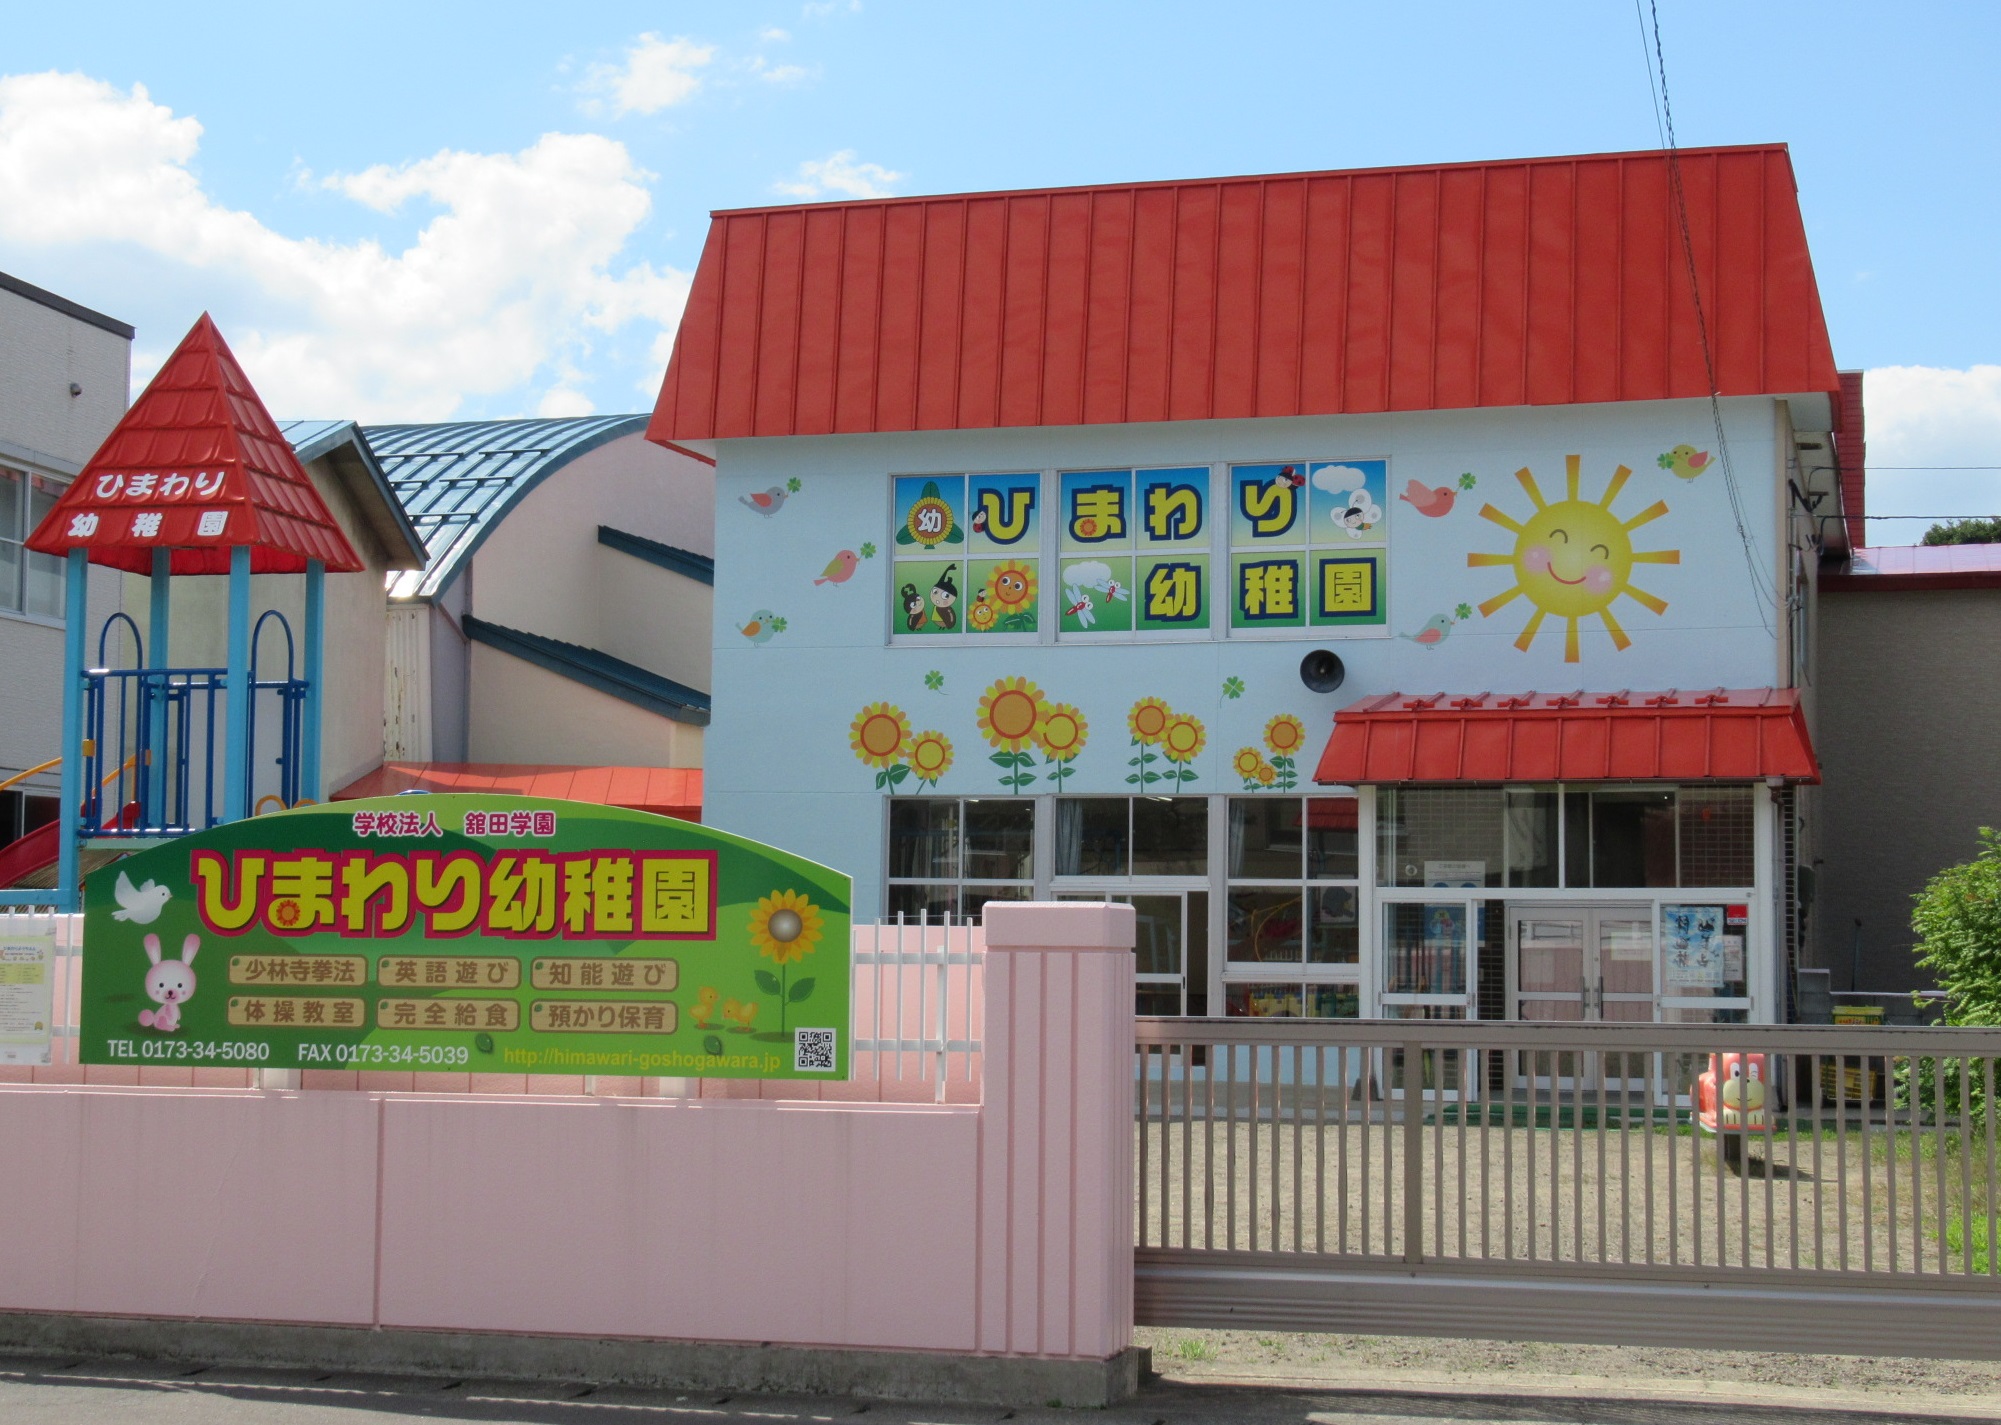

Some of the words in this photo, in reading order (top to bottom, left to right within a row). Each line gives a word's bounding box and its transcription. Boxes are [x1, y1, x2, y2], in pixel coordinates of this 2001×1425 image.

[96, 471, 225, 498] ひまわり
[68, 511, 229, 537] 幼稚園
[917, 507, 943, 534] 幼
[978, 480, 1298, 544] ひまわり
[1145, 556, 1377, 622] 幼稚園
[354, 811, 443, 837] 学校法人
[192, 850, 716, 939] ひまわり幼稚園
[245, 958, 355, 983] 少林寺拳法
[395, 960, 509, 983] 英語遊び
[549, 961, 667, 986] 知能遊び
[244, 999, 355, 1023] 体操教室
[394, 1002, 508, 1025] 完全給食
[548, 1004, 666, 1029] 預かり保育
[107, 1040, 138, 1058] TEL
[142, 1040, 270, 1060] 0173-34-5080
[298, 1043, 332, 1062] FAX
[336, 1043, 469, 1065] 0173-34-5039
[504, 1047, 782, 1072] http://himawari-goshogawara.jp
